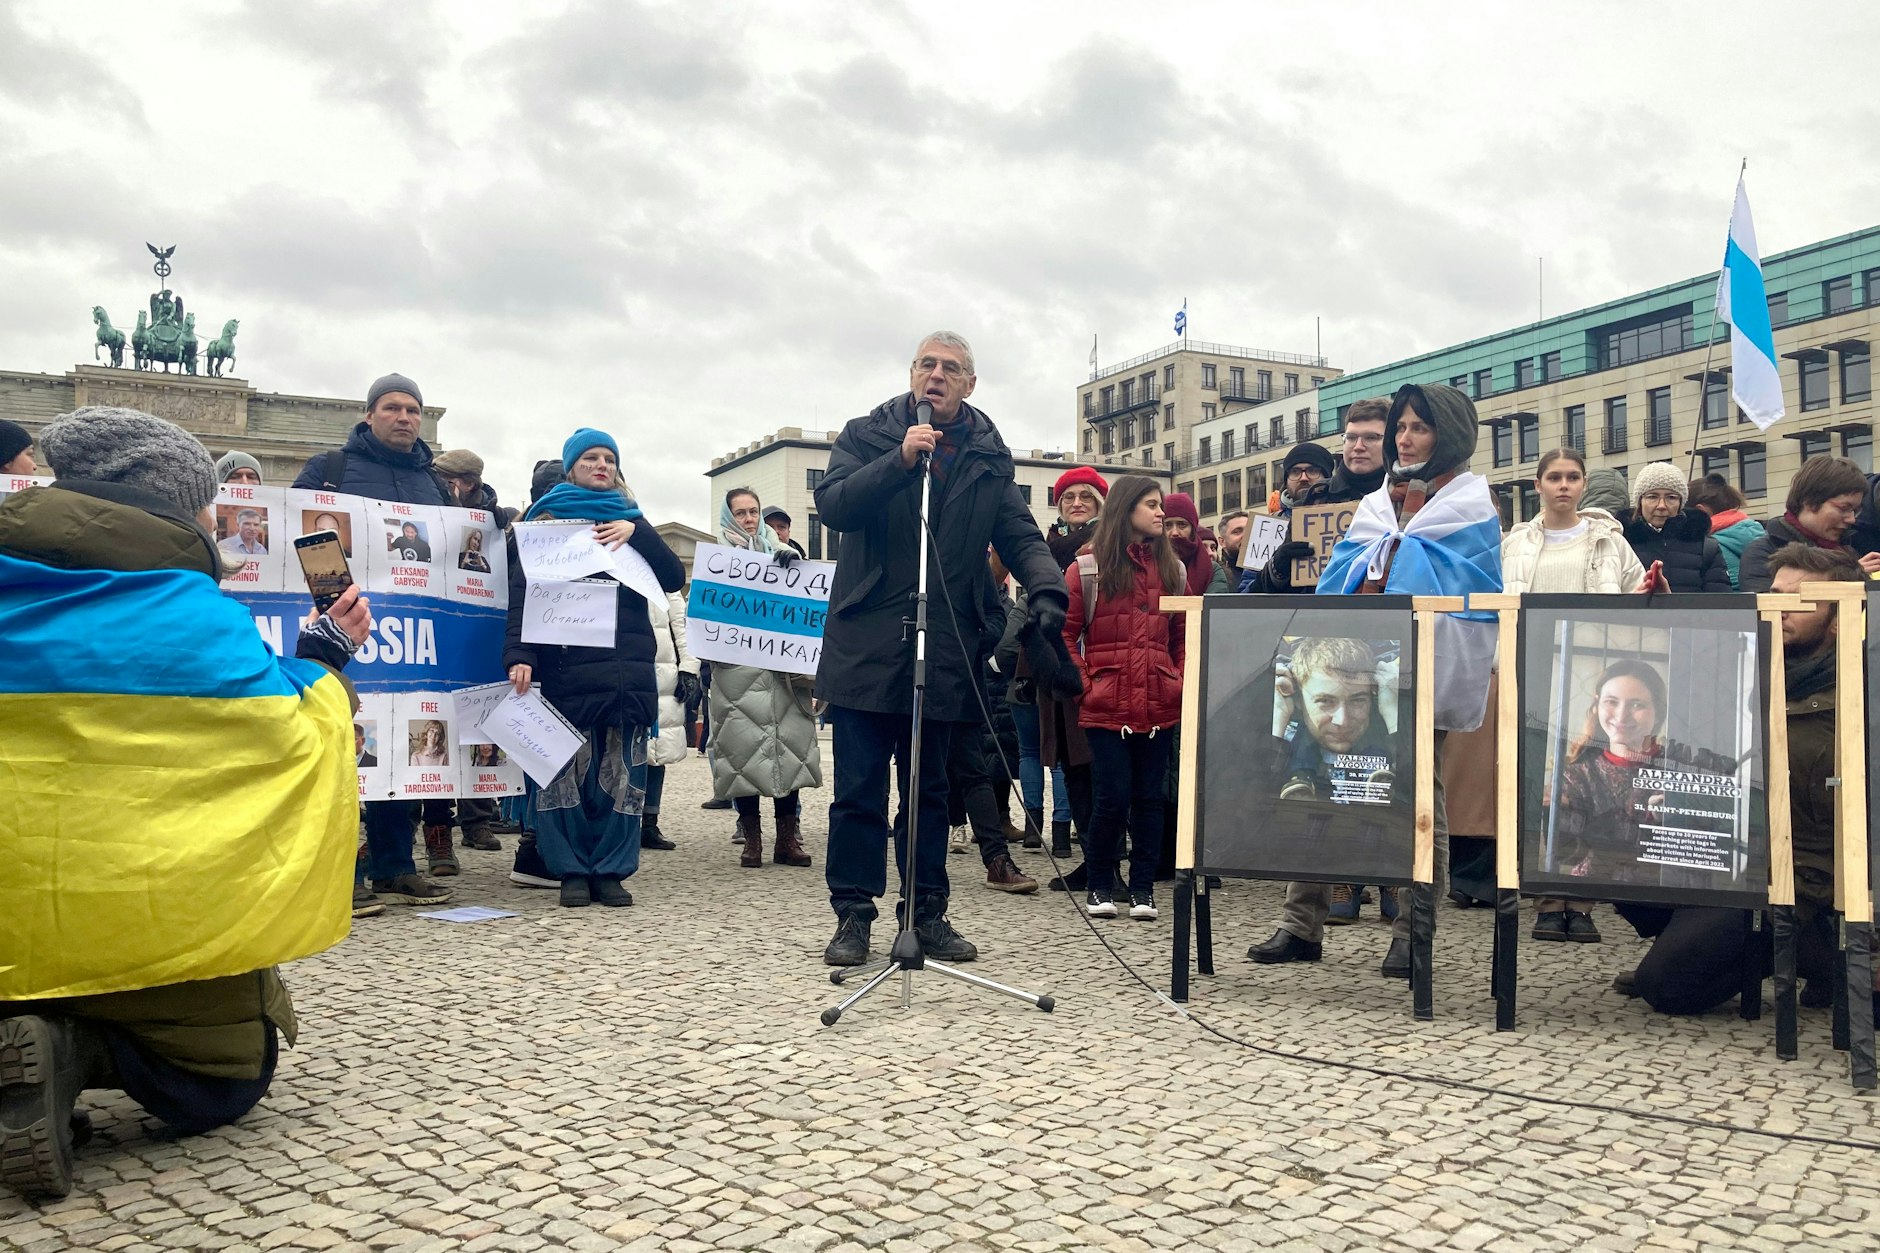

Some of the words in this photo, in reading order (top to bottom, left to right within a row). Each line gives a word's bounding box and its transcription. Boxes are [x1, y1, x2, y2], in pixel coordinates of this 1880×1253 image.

[230, 487, 254, 500] FREE
[314, 494, 336, 506] FREE
[392, 504, 413, 516] FREE
[470, 511, 487, 523] FREE
[1259, 520, 1285, 540] FR
[1303, 510, 1353, 538] FIG
[521, 533, 569, 548] Андрей
[1322, 534, 1345, 555] FO
[391, 566, 430, 578] ALEKSANDR
[707, 552, 829, 596] СВОБОД
[1296, 556, 1331, 580] FRE
[394, 576, 428, 588] GABYSHEV
[466, 577, 484, 588] MARIA
[456, 585, 494, 598] PONOMARENKO
[530, 583, 592, 603] Вадим
[702, 588, 827, 628] ПОЛИТИЧЕС
[250, 616, 283, 656] N
[461, 693, 508, 708] Заре
[421, 702, 438, 713] FREE
[508, 693, 557, 733] Алексей
[1338, 755, 1386, 763] VALENTIN
[421, 773, 441, 782] ELENA
[478, 774, 498, 782] MARIA
[1640, 768, 1736, 787] ALEXANDRA
[404, 784, 454, 794] TARDASOVA-YUN
[472, 783, 508, 792] SEMERENKO
[1633, 779, 1741, 798] SKOCHILENKO
[1648, 805, 1738, 820] SAINT-PETERSBURG
[1653, 836, 1680, 844] switching
[1640, 841, 1679, 849] supermarkets
[1694, 846, 1728, 854] information
